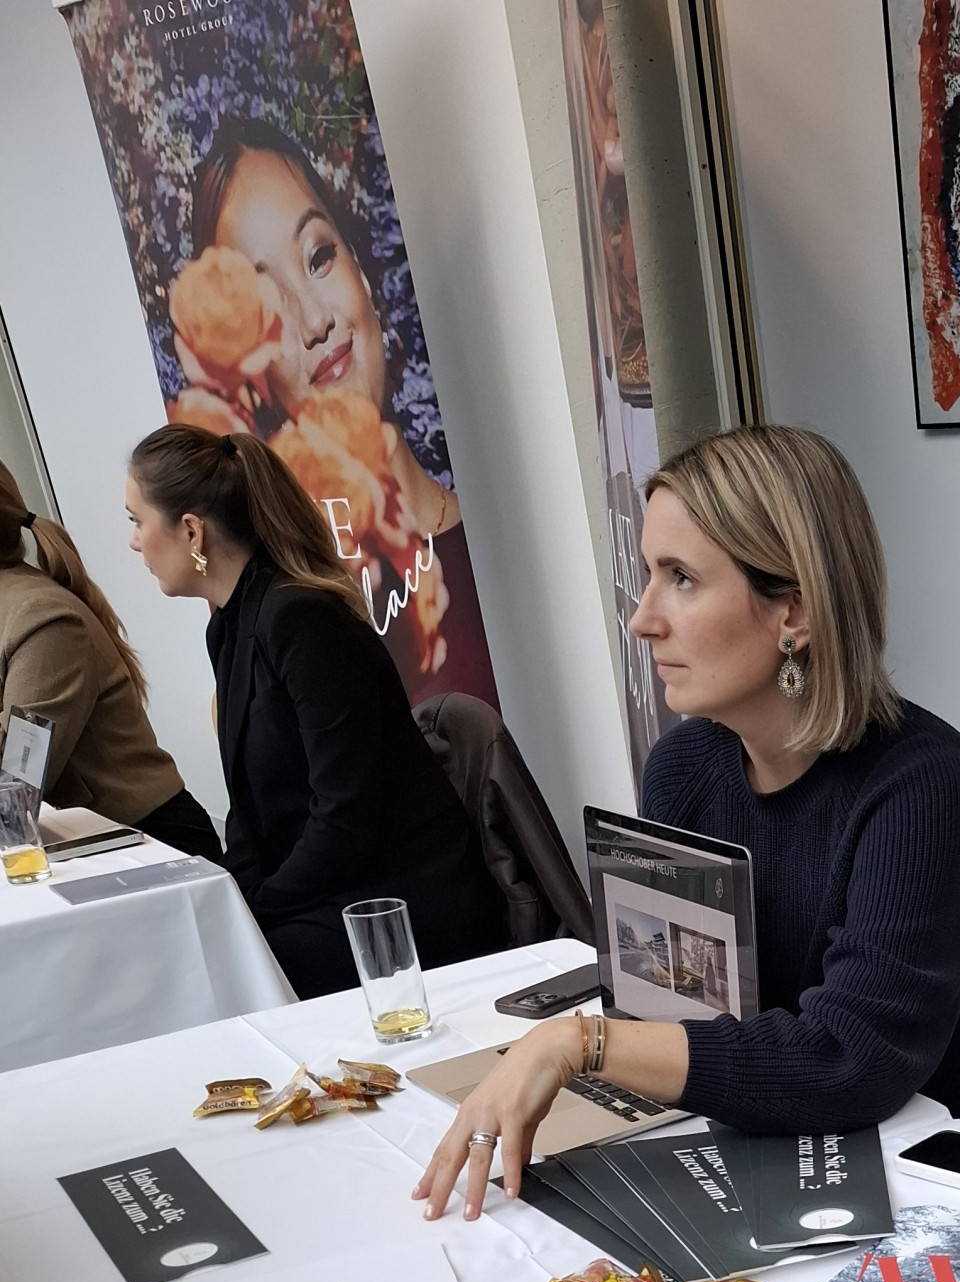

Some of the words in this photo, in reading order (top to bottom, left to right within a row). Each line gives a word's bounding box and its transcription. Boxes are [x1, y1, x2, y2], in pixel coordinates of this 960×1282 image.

[142, 0, 232, 27] ROSEW
[164, 25, 198, 42] HOTEL
[201, 14, 234, 32] GROUP
[656, 861, 678, 879] HEUTE
[799, 1137, 813, 1155] zenz
[824, 1135, 843, 1153] ben
[799, 1157, 814, 1176] zum
[825, 1156, 846, 1168] Sie
[129, 1168, 160, 1196] Haben
[673, 1149, 708, 1178] Lizenz
[698, 1179, 726, 1199] zum
[826, 1171, 847, 1184] die
[103, 1175, 133, 1203] Lizenz
[122, 1202, 148, 1222] zum
[149, 1194, 174, 1209] Sie
[160, 1209, 186, 1223] die
